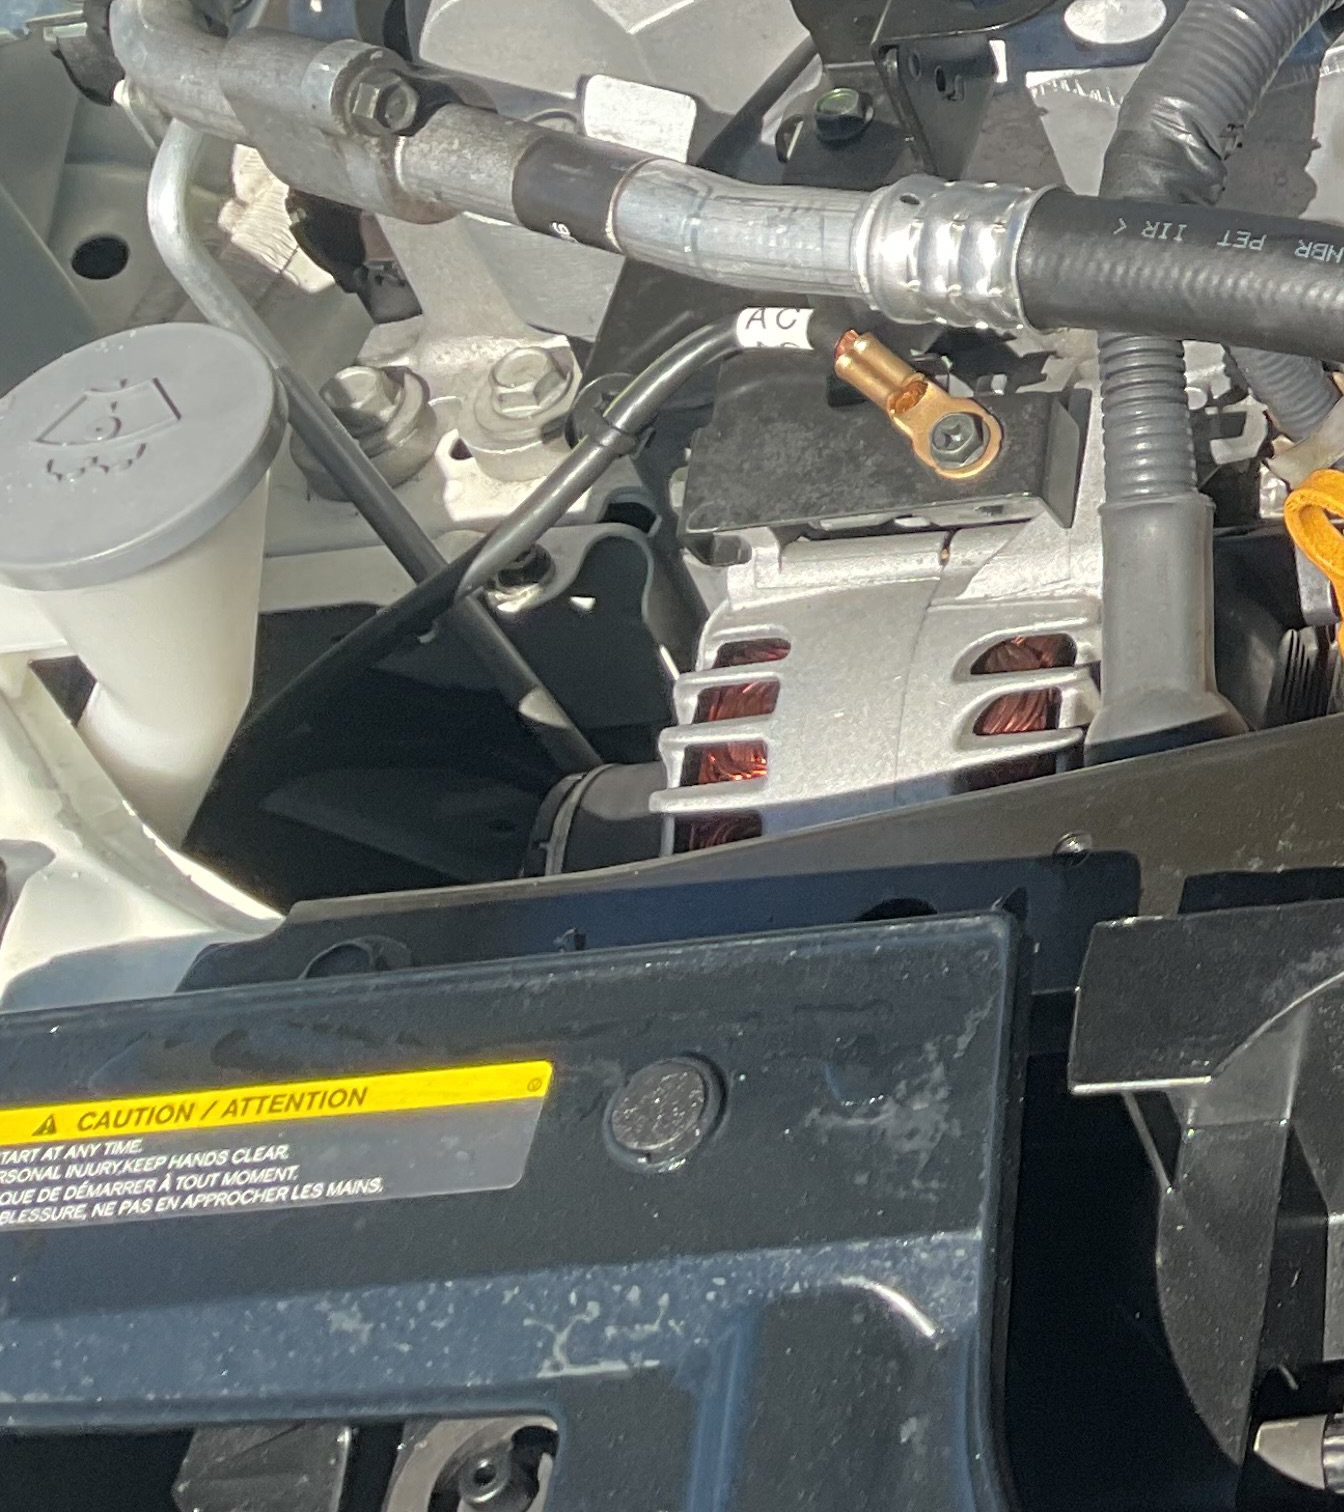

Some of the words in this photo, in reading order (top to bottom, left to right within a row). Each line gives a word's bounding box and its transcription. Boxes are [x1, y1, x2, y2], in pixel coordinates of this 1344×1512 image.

[1217, 229, 1264, 254] PET
[1295, 236, 1344, 264] NBR
[76, 1103, 194, 1132] CAUTION
[221, 1087, 368, 1117] ATTENTION
[44, 1141, 64, 1159] AT
[65, 1140, 99, 1157] ANY
[102, 1138, 142, 1155] TIME.
[166, 1150, 229, 1170] HANDS
[232, 1145, 289, 1164] CLEAR.
[43, 1184, 61, 1203] DE
[64, 1175, 159, 1201] DÉMARRER
[177, 1172, 219, 1192] TOUT
[221, 1164, 297, 1188] MOMENT.
[92, 1201, 116, 1218] NE
[119, 1198, 153, 1216] PAS
[156, 1194, 178, 1212] EN
[180, 1186, 291, 1210] APPROCHER
[292, 1183, 324, 1201] LES
